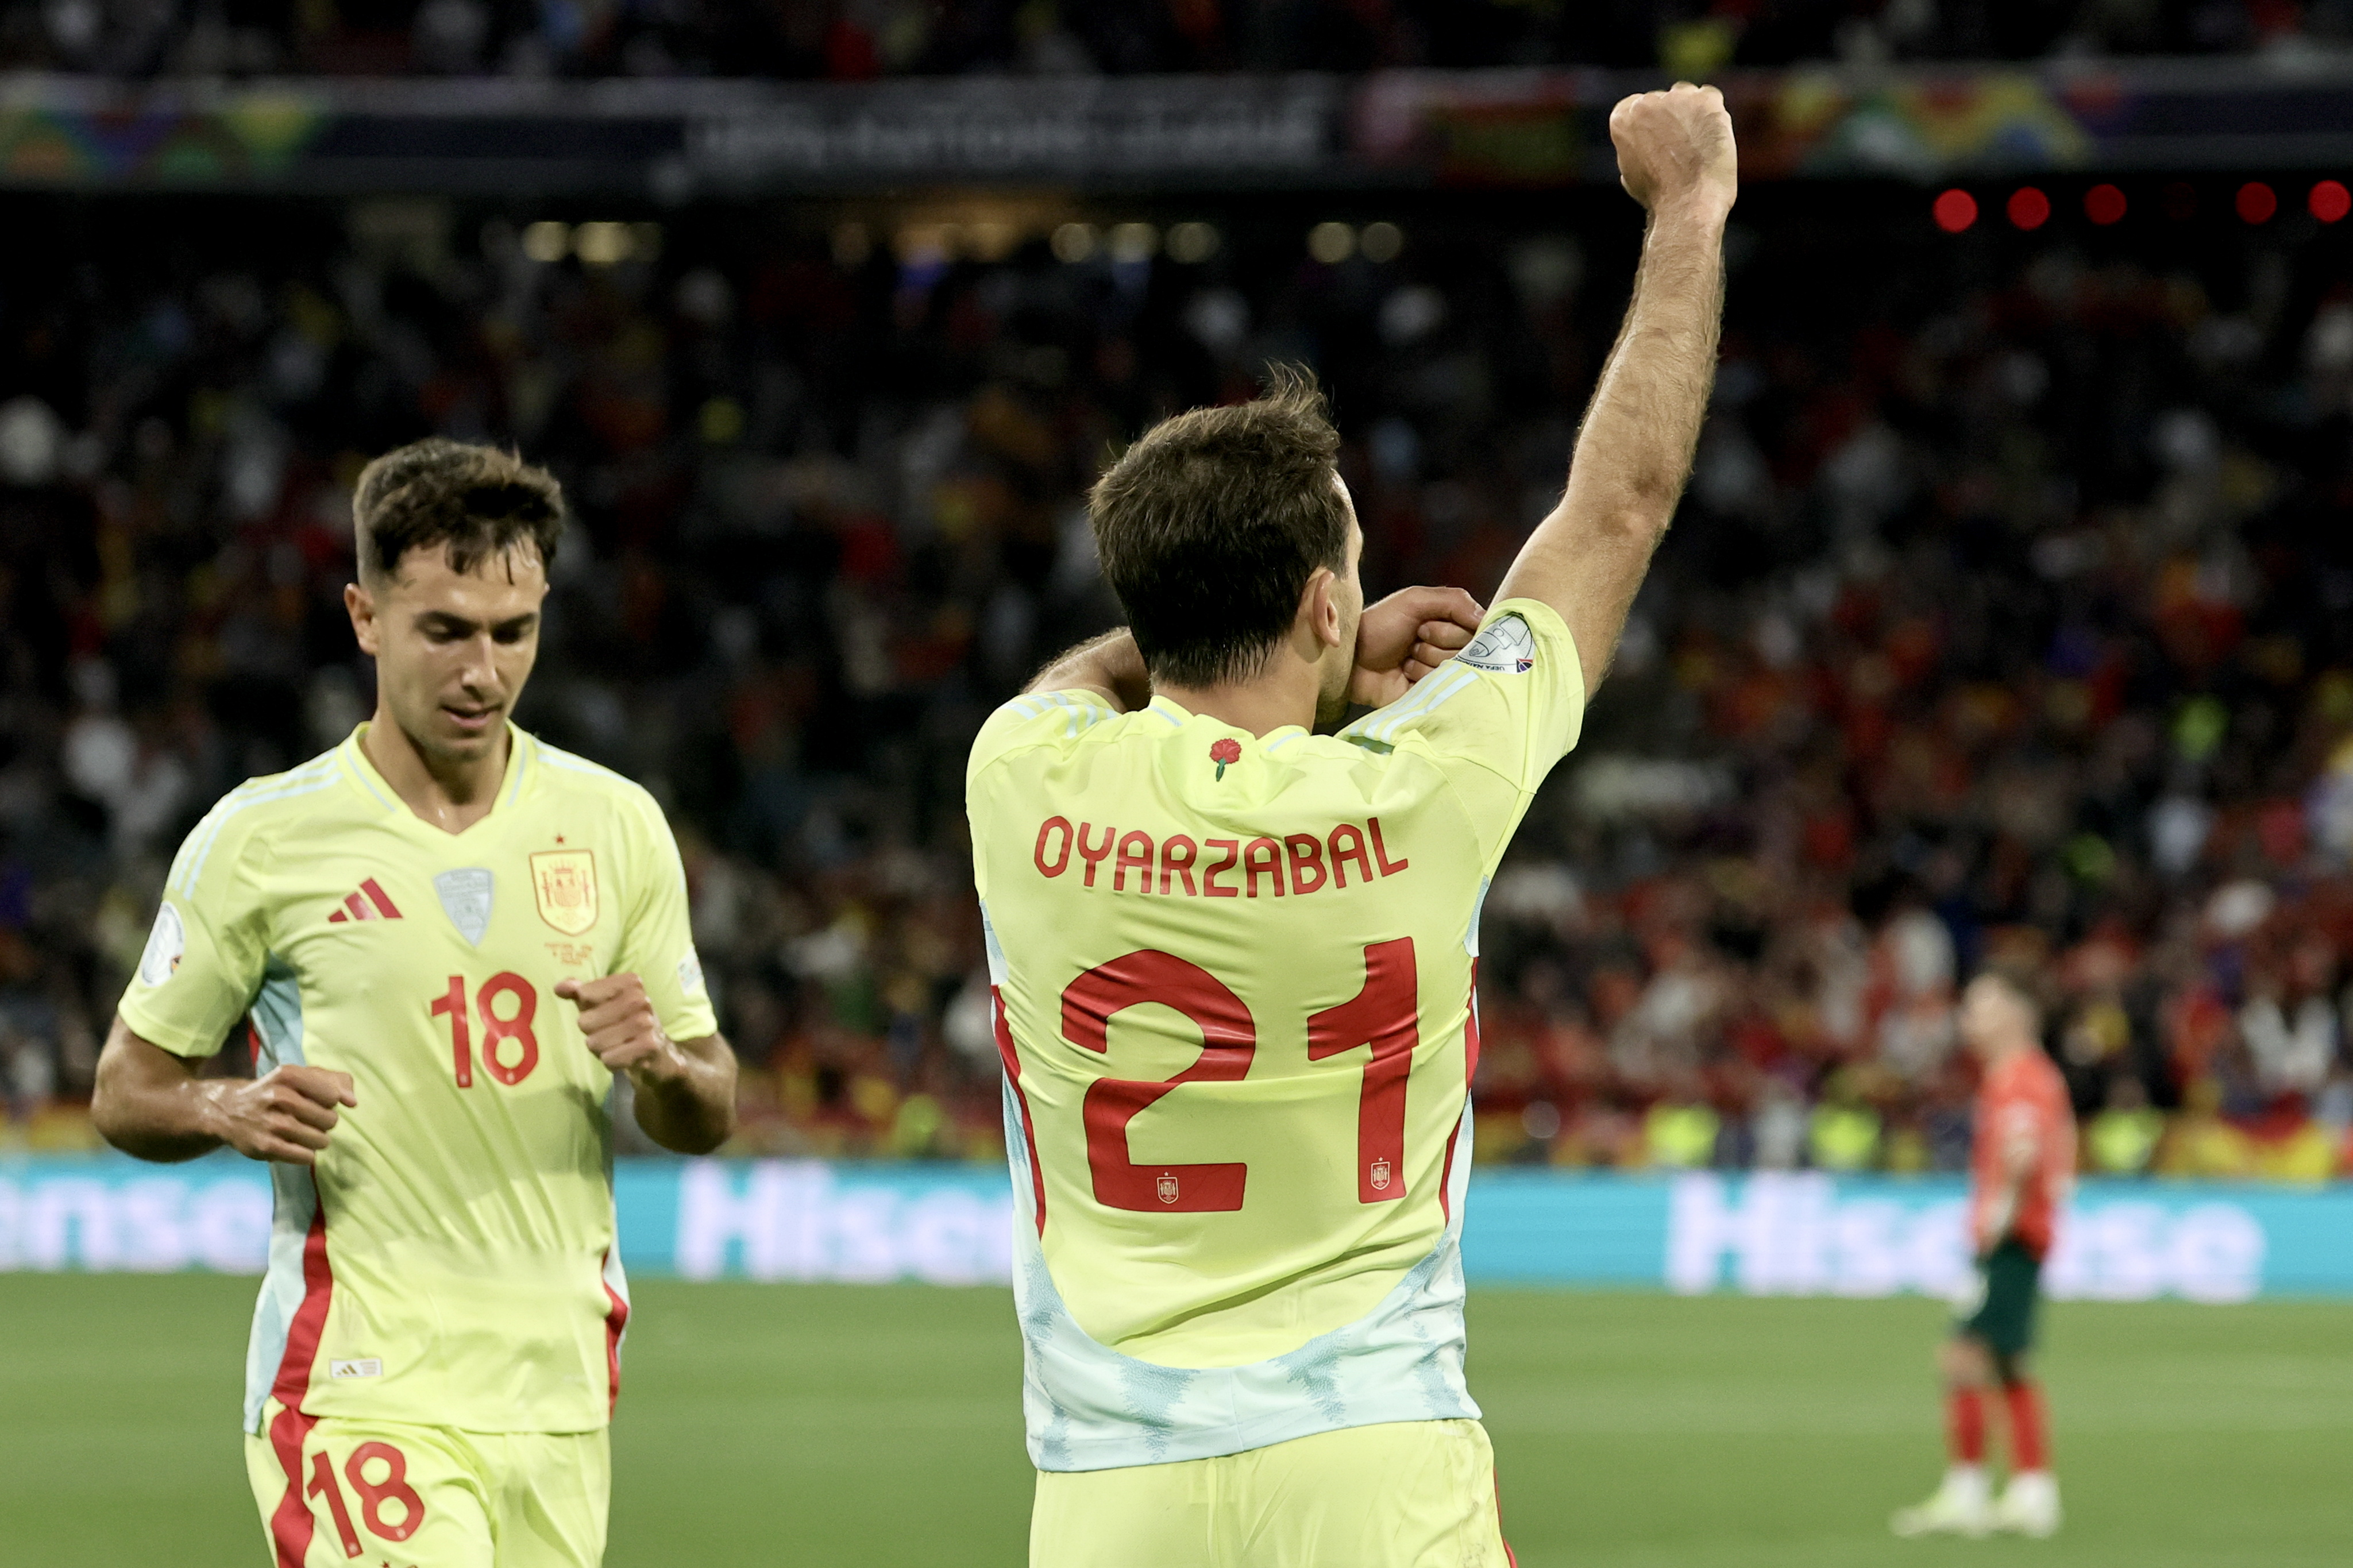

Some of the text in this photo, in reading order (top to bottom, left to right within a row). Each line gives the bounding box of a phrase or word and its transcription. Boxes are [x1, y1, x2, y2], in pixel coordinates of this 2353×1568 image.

[1034, 816, 1408, 897] OYARZABAL
[431, 971, 538, 1088] 18
[1061, 936, 1418, 1212] 21
[307, 1442, 425, 1559] 18
